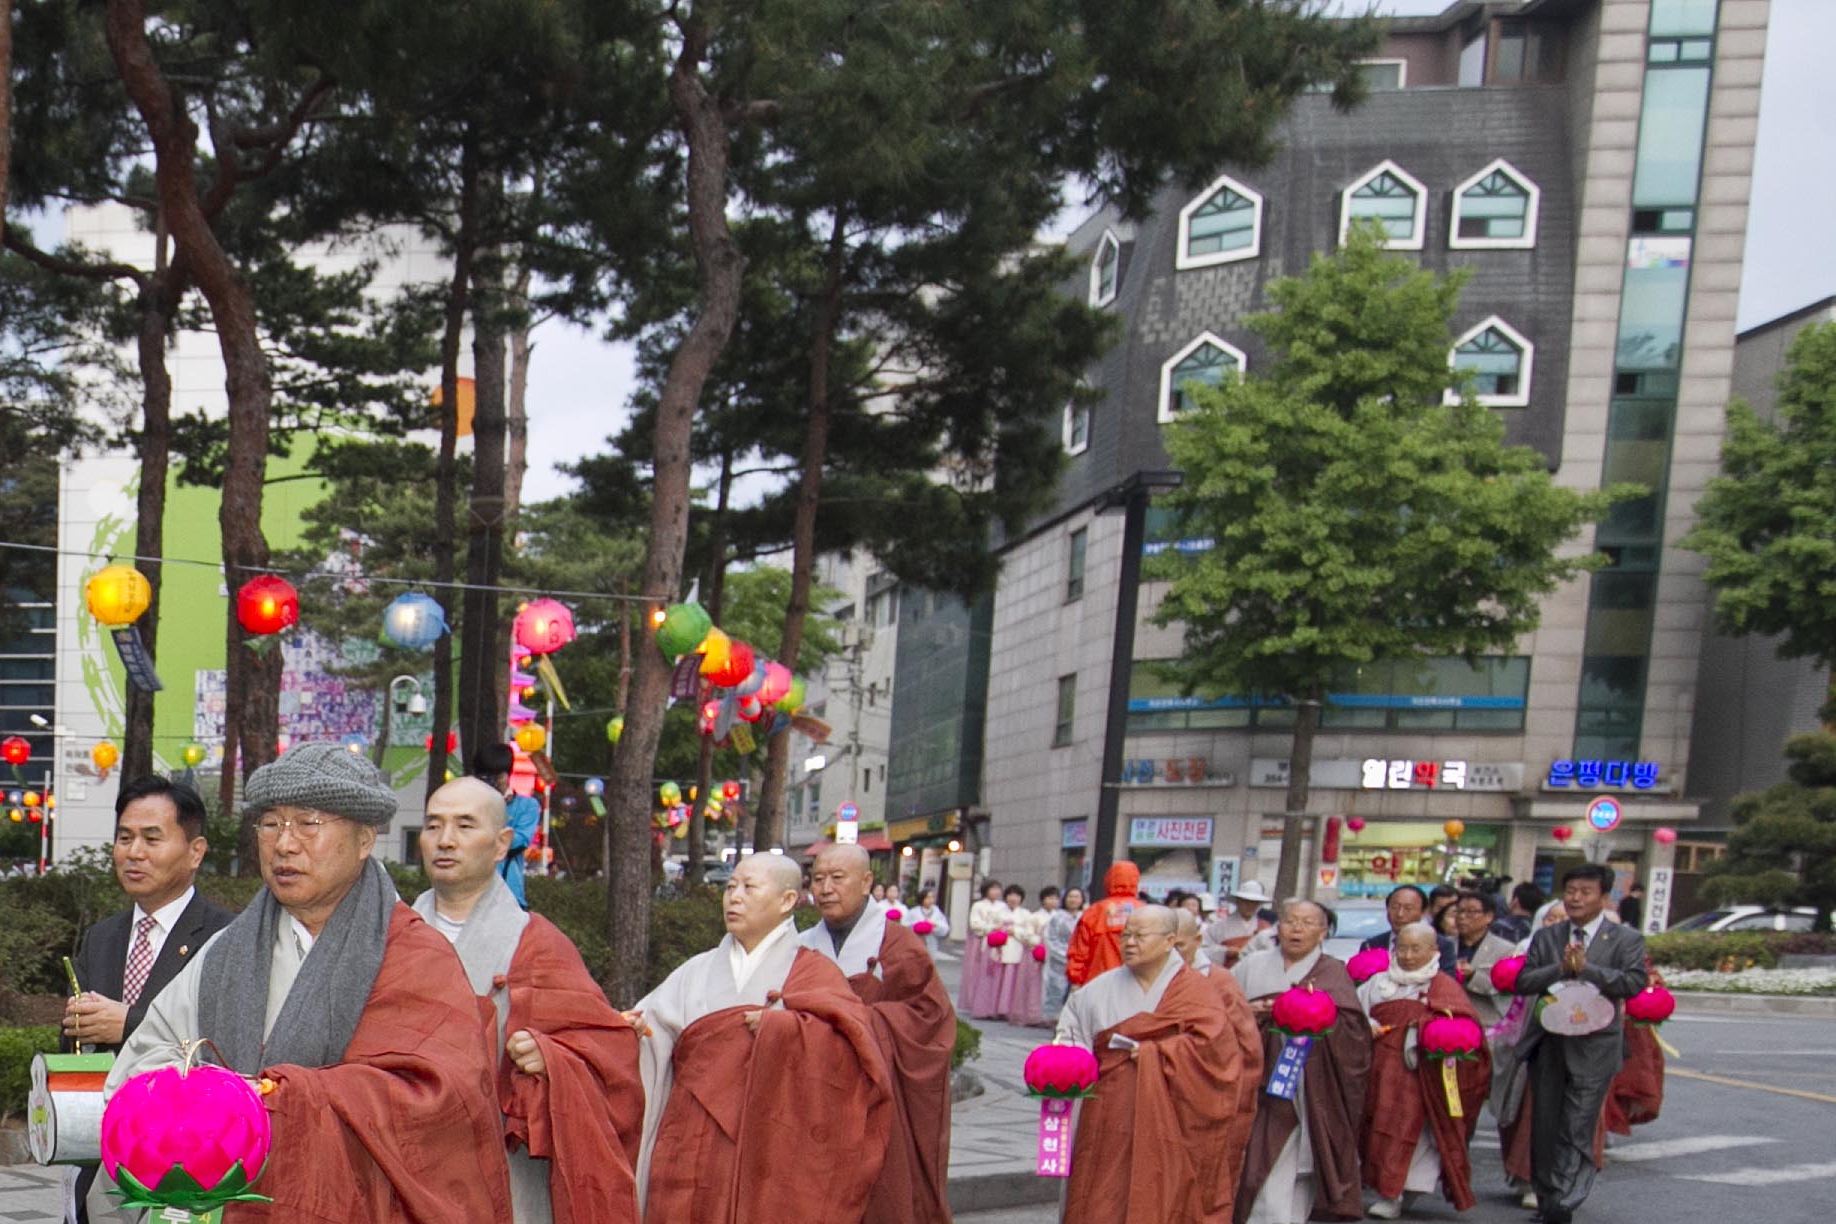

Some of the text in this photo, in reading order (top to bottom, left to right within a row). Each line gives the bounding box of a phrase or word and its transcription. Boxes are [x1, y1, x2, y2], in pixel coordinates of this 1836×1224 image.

[1363, 758, 1466, 789] 열린약국
[1548, 760, 1658, 788] 은평다방
[1156, 821, 1208, 841] 사진전문
[1371, 853, 1398, 881] 약
[1041, 1116, 1059, 1173] 삼천사
